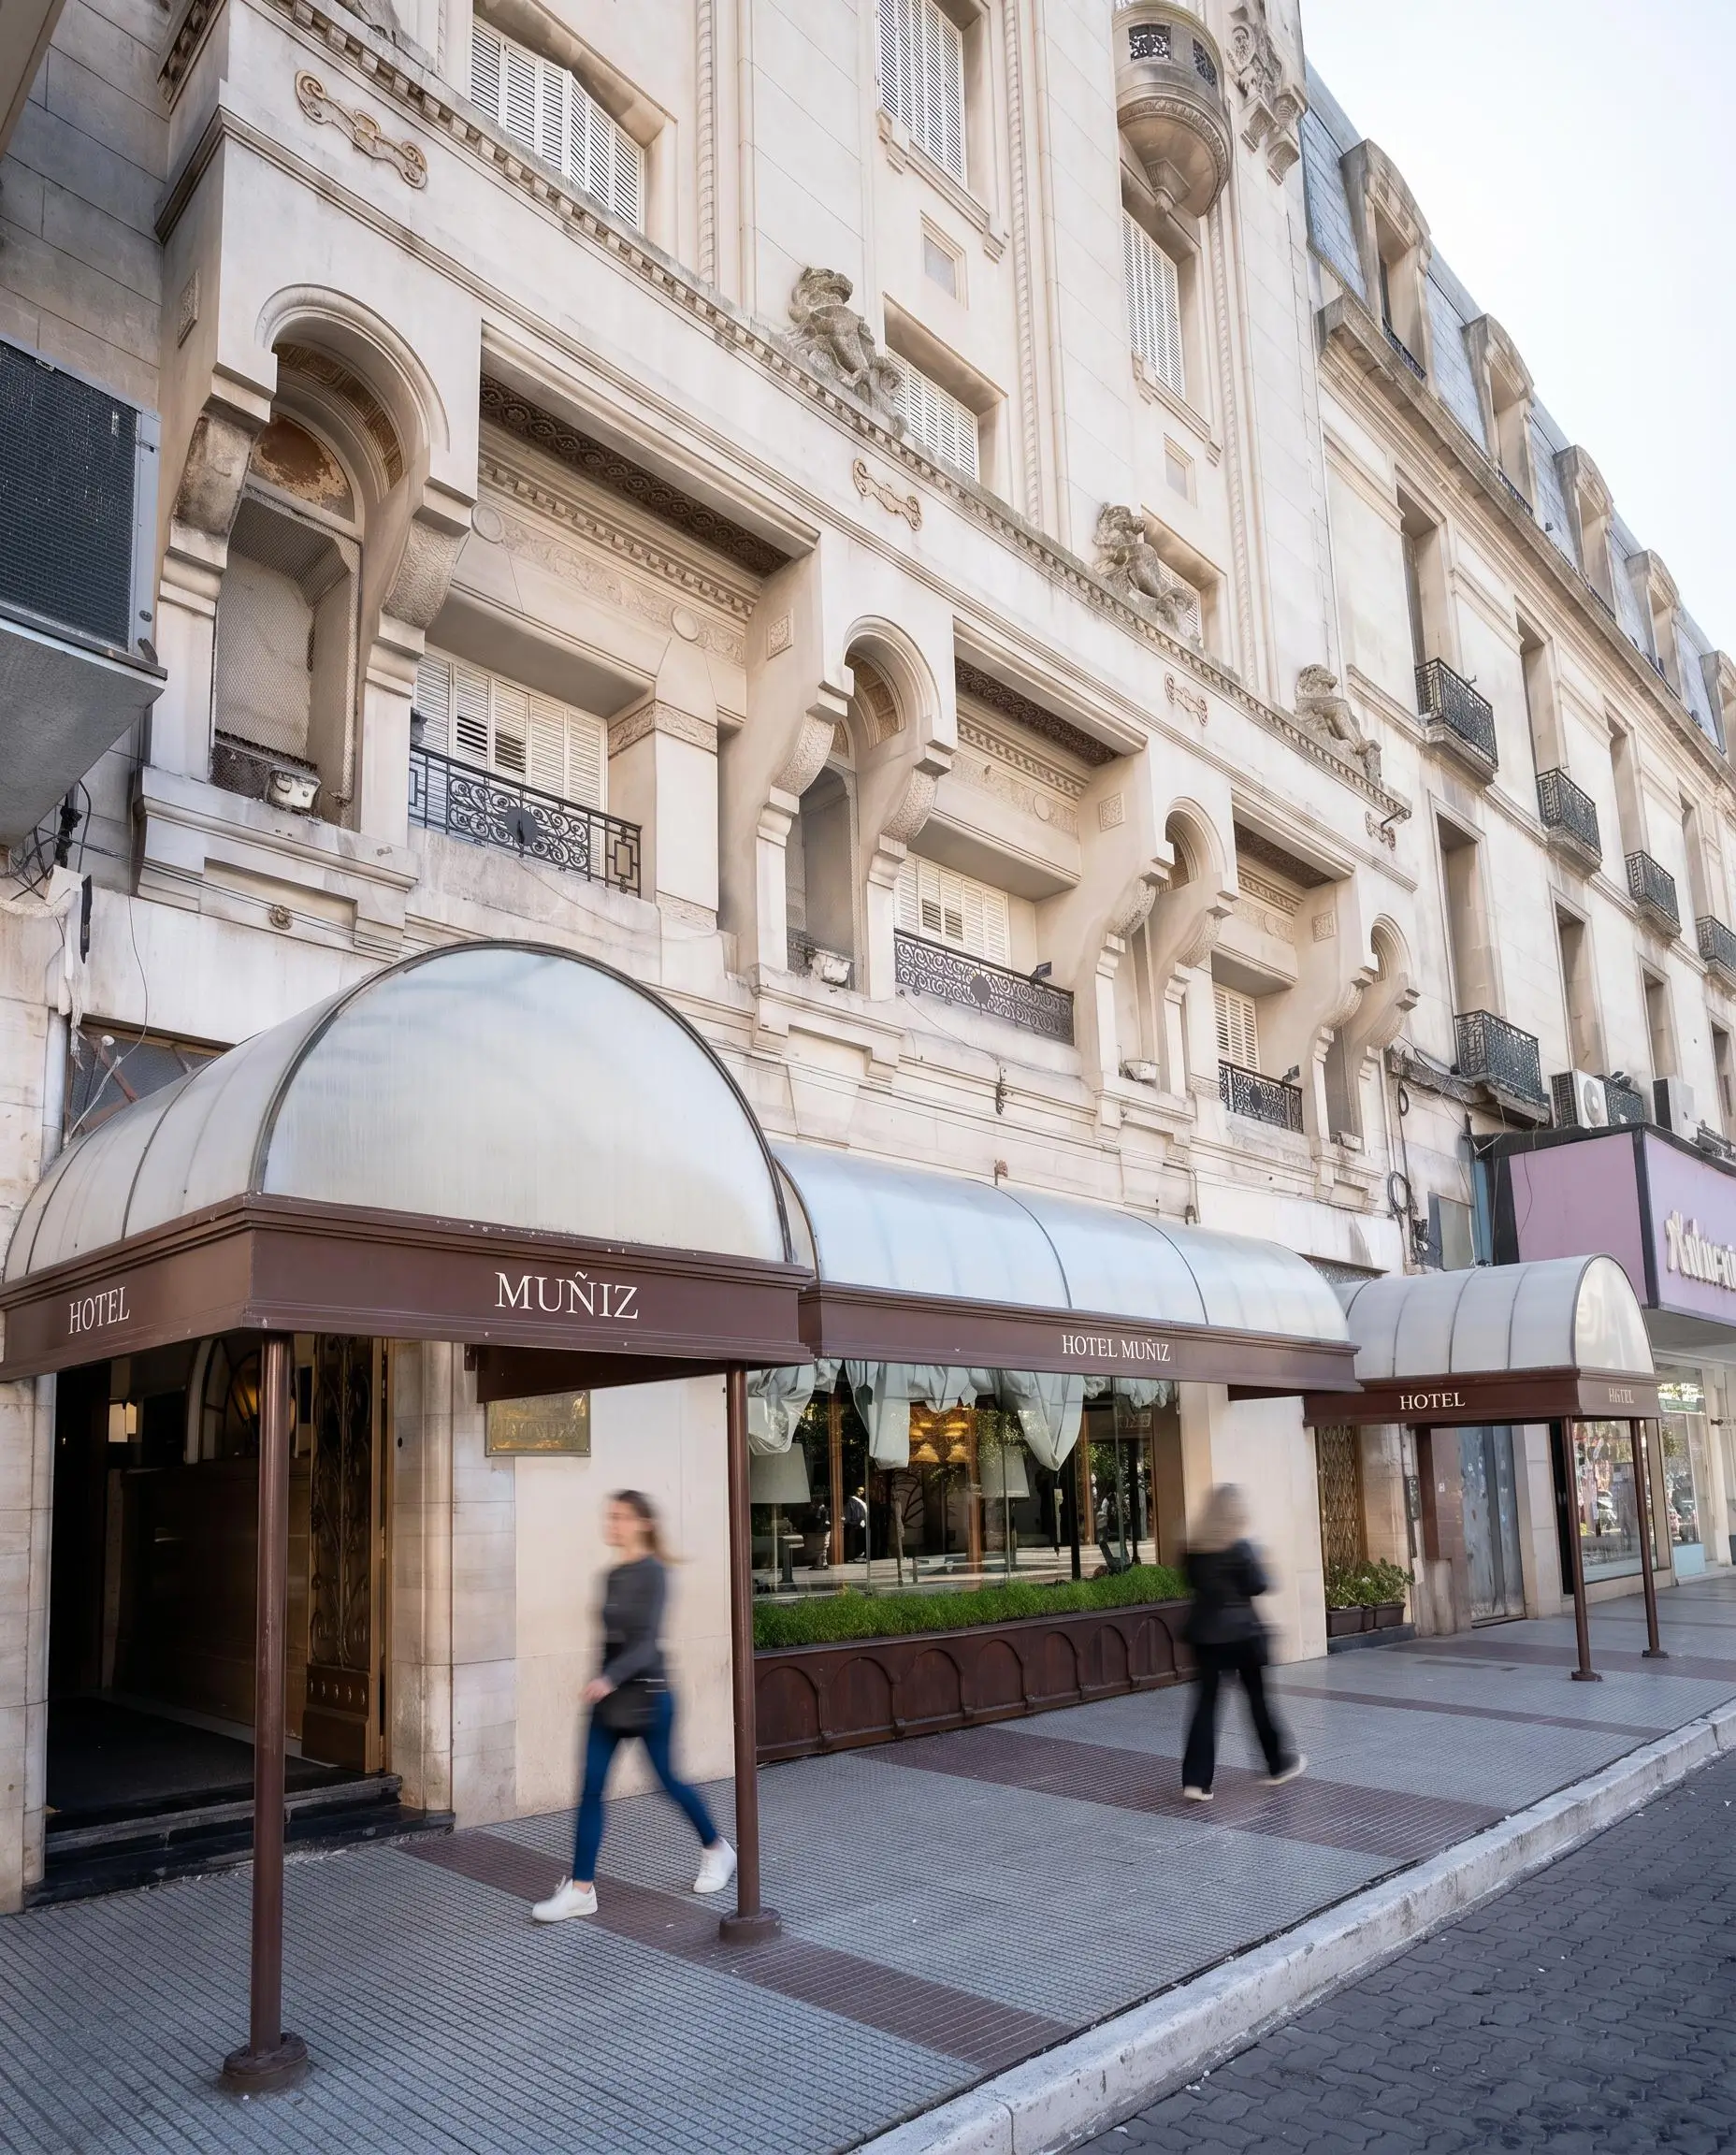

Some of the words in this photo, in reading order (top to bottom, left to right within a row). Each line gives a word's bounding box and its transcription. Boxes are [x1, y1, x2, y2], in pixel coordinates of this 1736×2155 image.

[67, 1286, 131, 1335] HOTEL
[495, 1270, 640, 1321] MUÑIZ
[1062, 1334, 1118, 1358] HOTEL
[1121, 1338, 1171, 1362] MUÑIZ
[1399, 1392, 1466, 1410] HOTEL
